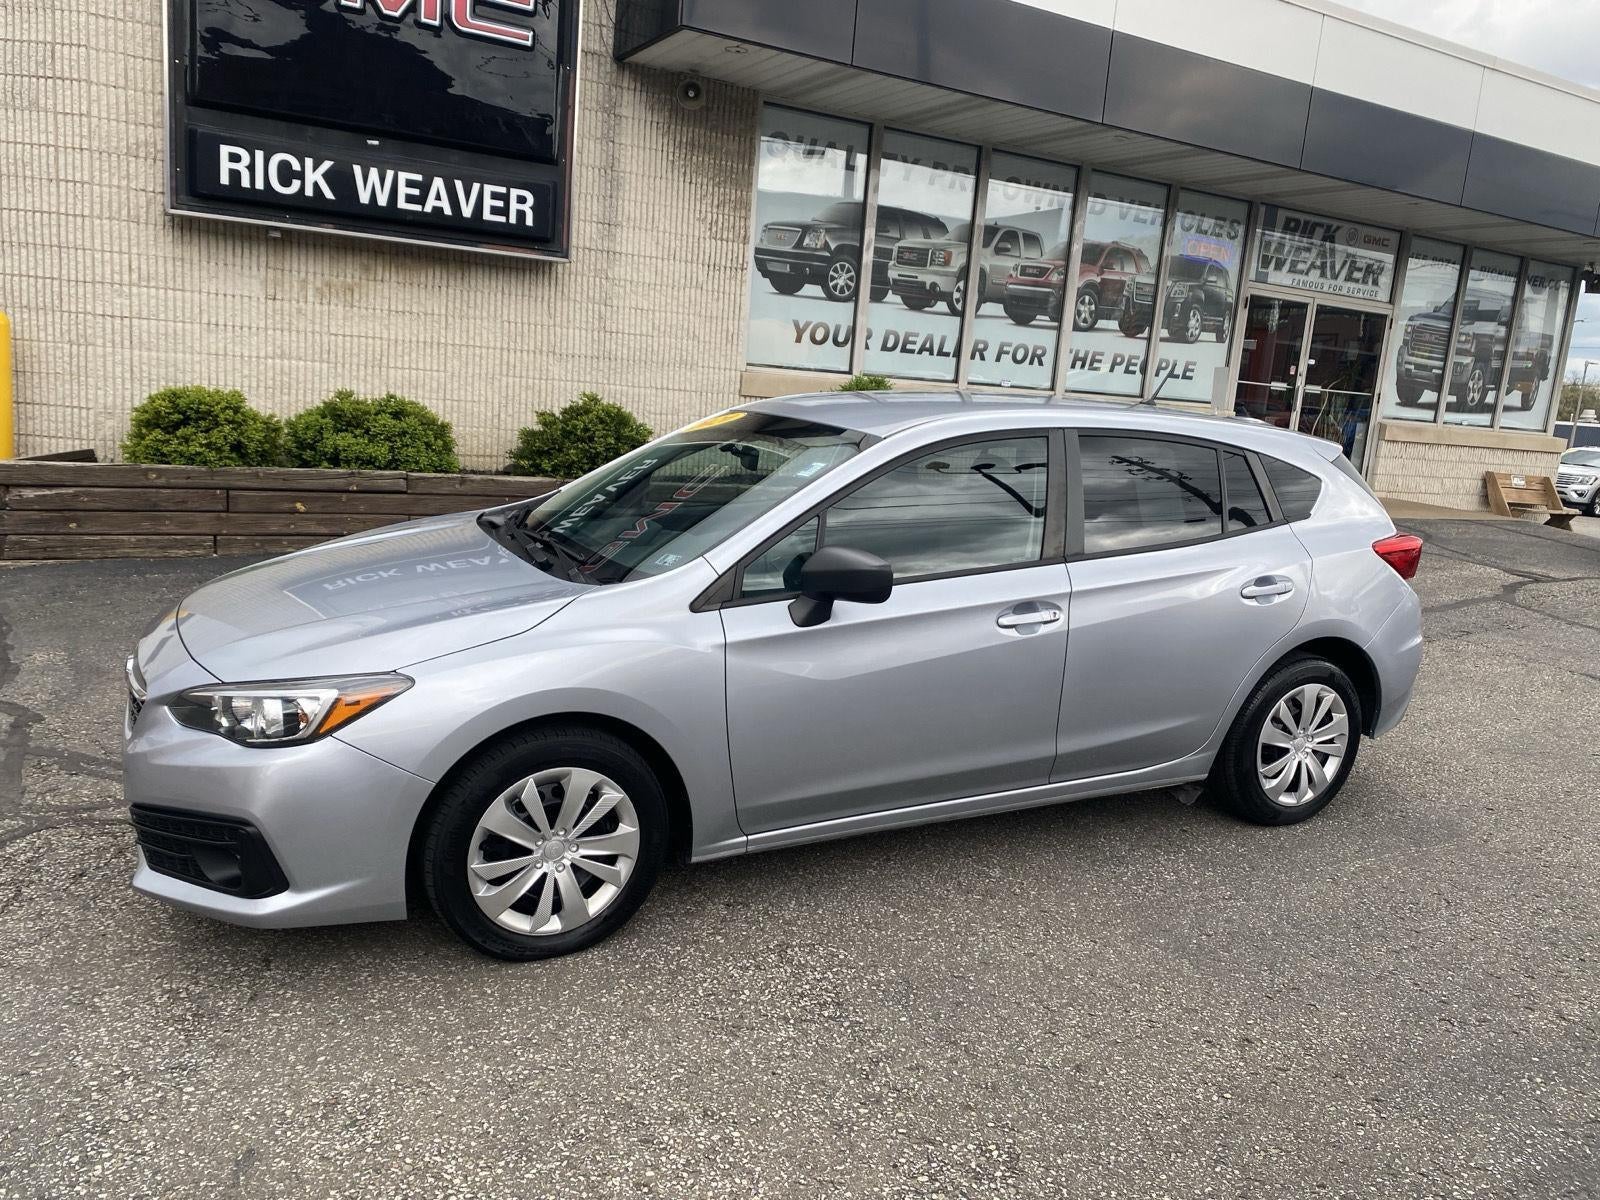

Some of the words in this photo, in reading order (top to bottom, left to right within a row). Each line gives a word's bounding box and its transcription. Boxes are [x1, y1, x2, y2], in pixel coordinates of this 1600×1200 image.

[219, 144, 336, 200] RICK
[353, 164, 534, 227] WEAVER
[767, 131, 922, 182] QUALTY
[1117, 197, 1242, 241] VEHCLES
[1281, 215, 1343, 244] RICK
[1363, 234, 1392, 248] GMC
[1186, 239, 1232, 262] OPEN
[1260, 240, 1385, 287] WEAVER
[1291, 278, 1325, 292] FAMOUS
[1328, 283, 1343, 292] FOR
[1346, 286, 1379, 298] SERVICE
[995, 341, 1047, 367] FOR
[1069, 348, 1105, 371] HE
